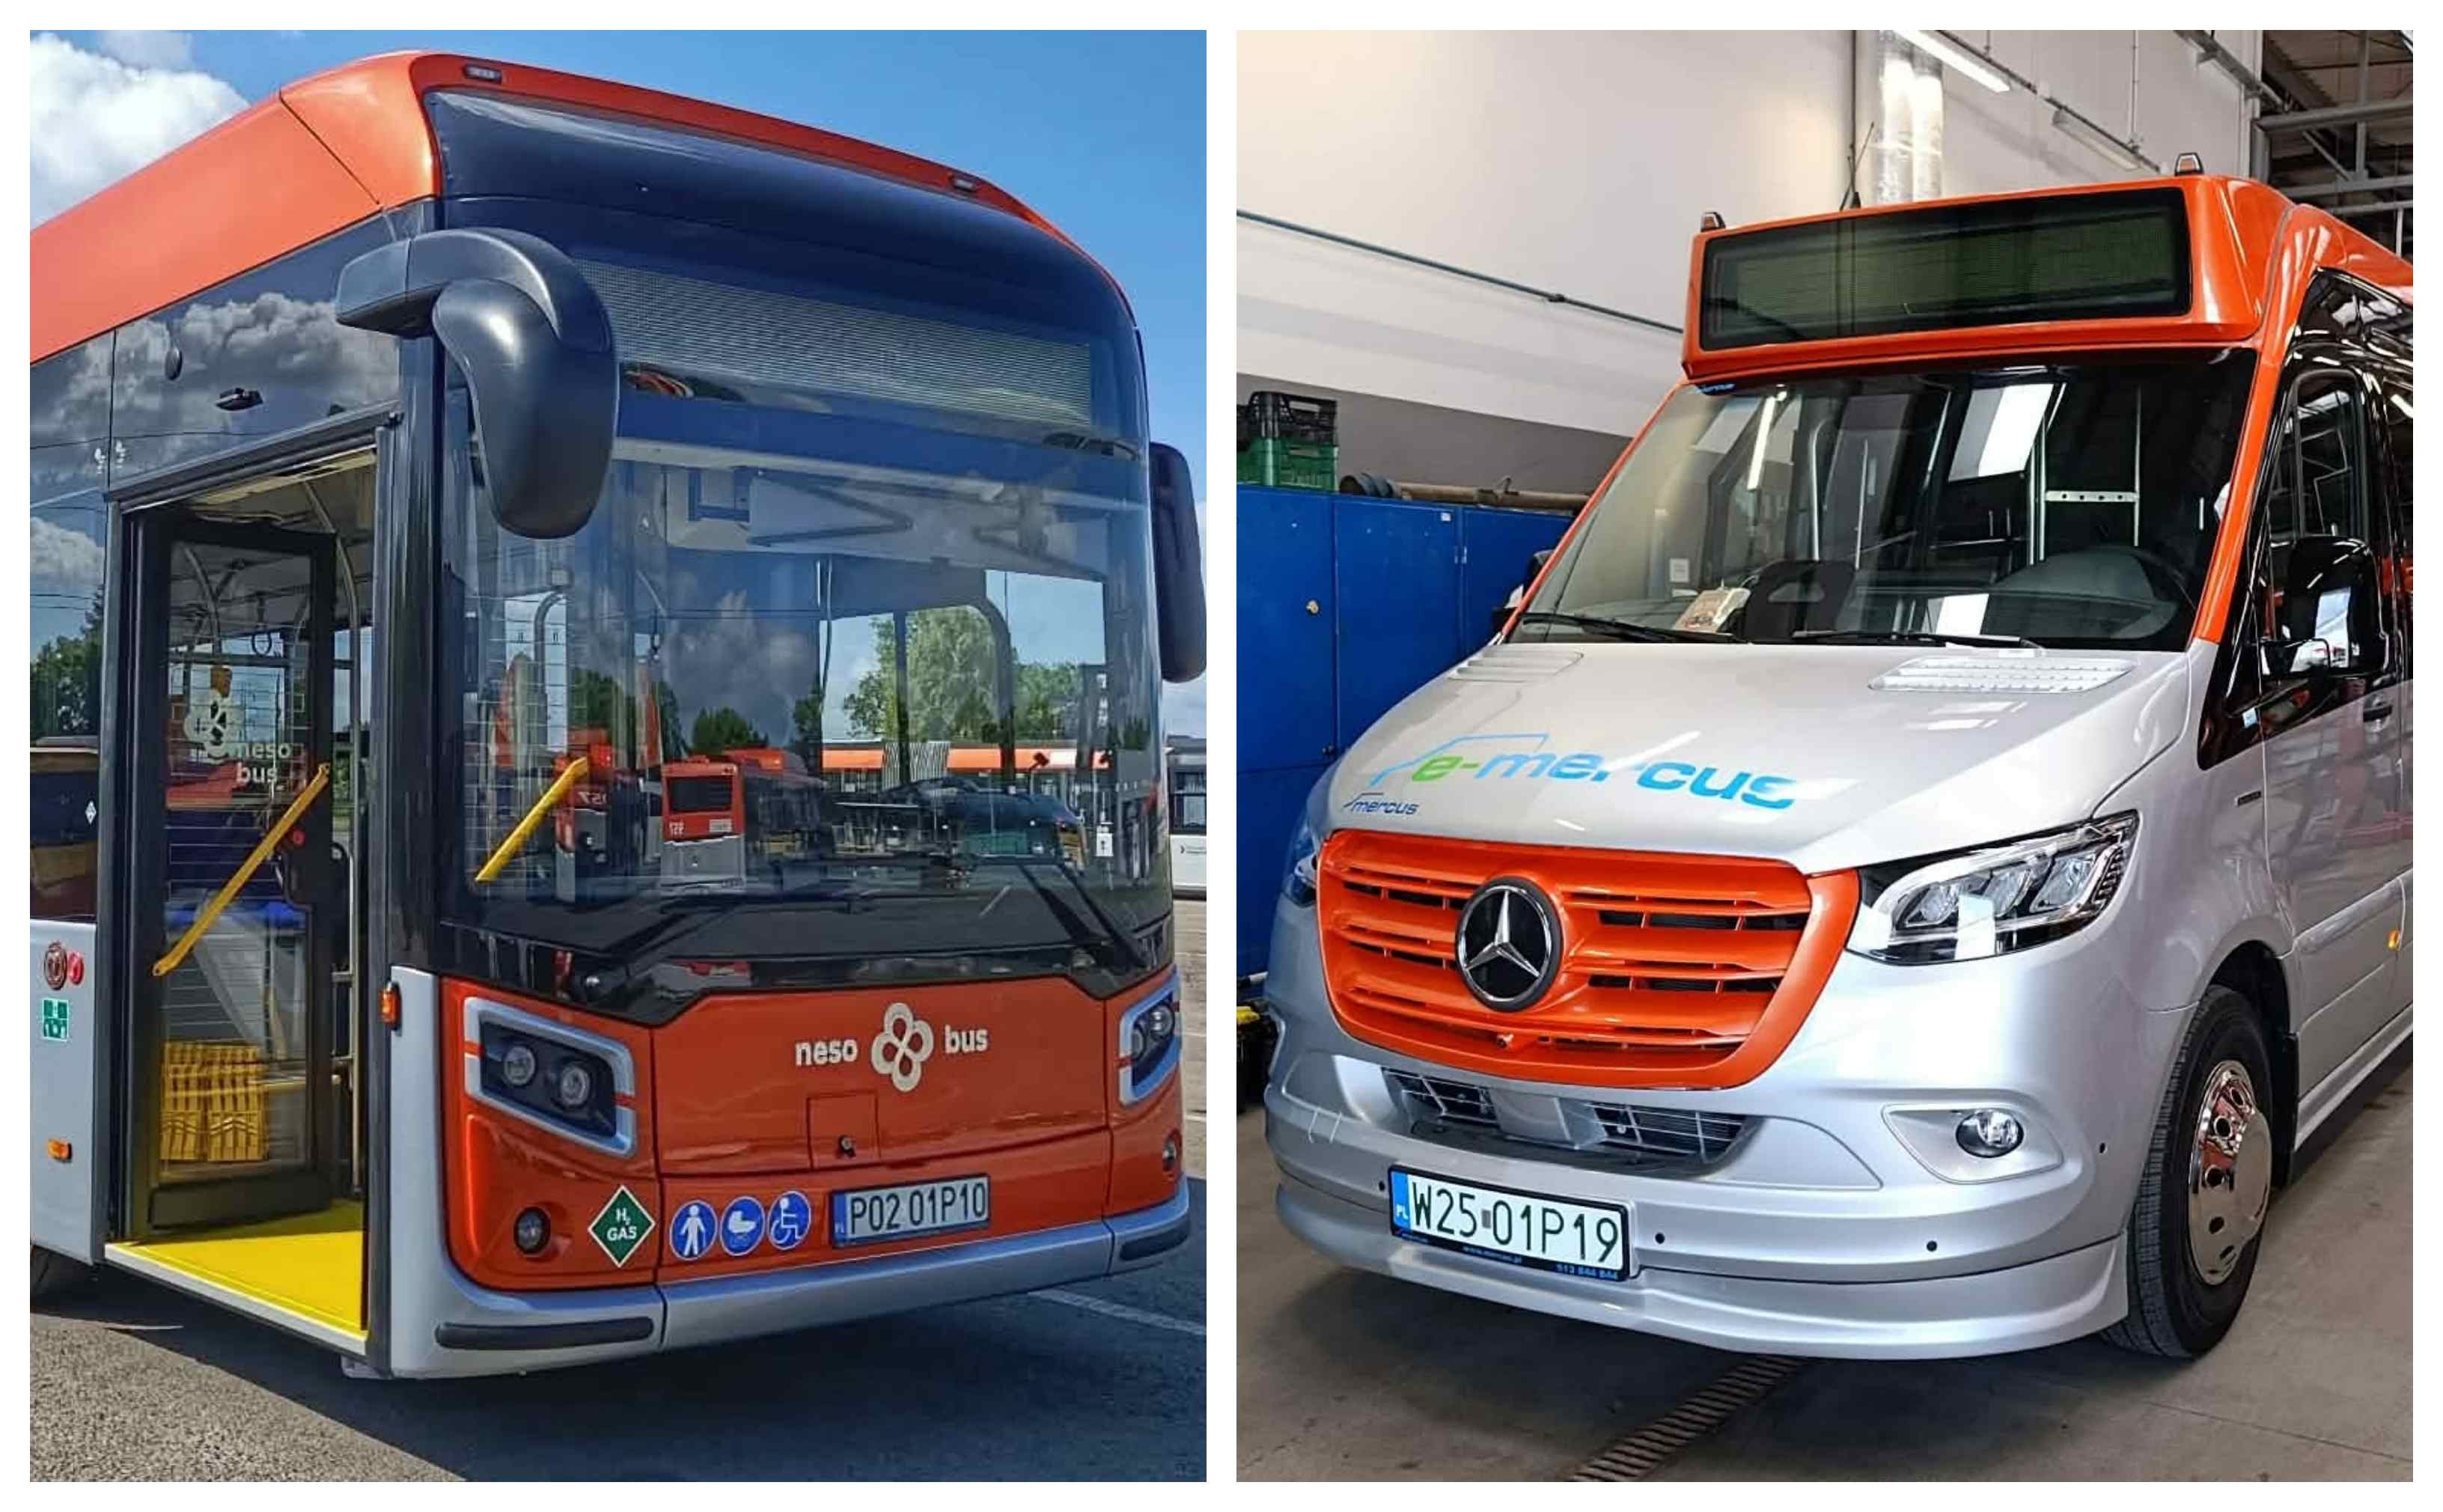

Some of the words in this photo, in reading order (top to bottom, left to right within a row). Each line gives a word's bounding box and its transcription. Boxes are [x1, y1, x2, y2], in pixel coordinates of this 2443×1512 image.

[236, 761, 278, 787] bus
[1350, 801, 1419, 815] mercus
[795, 1039, 858, 1066] neso
[945, 1025, 988, 1054] bus
[850, 1193, 900, 1234] P02
[909, 1182, 986, 1226] 01P10
[1395, 1204, 1409, 1220] PL
[606, 1225, 638, 1242] GAS
[1412, 1182, 1477, 1237] W25
[1492, 1200, 1618, 1263] 01P19
